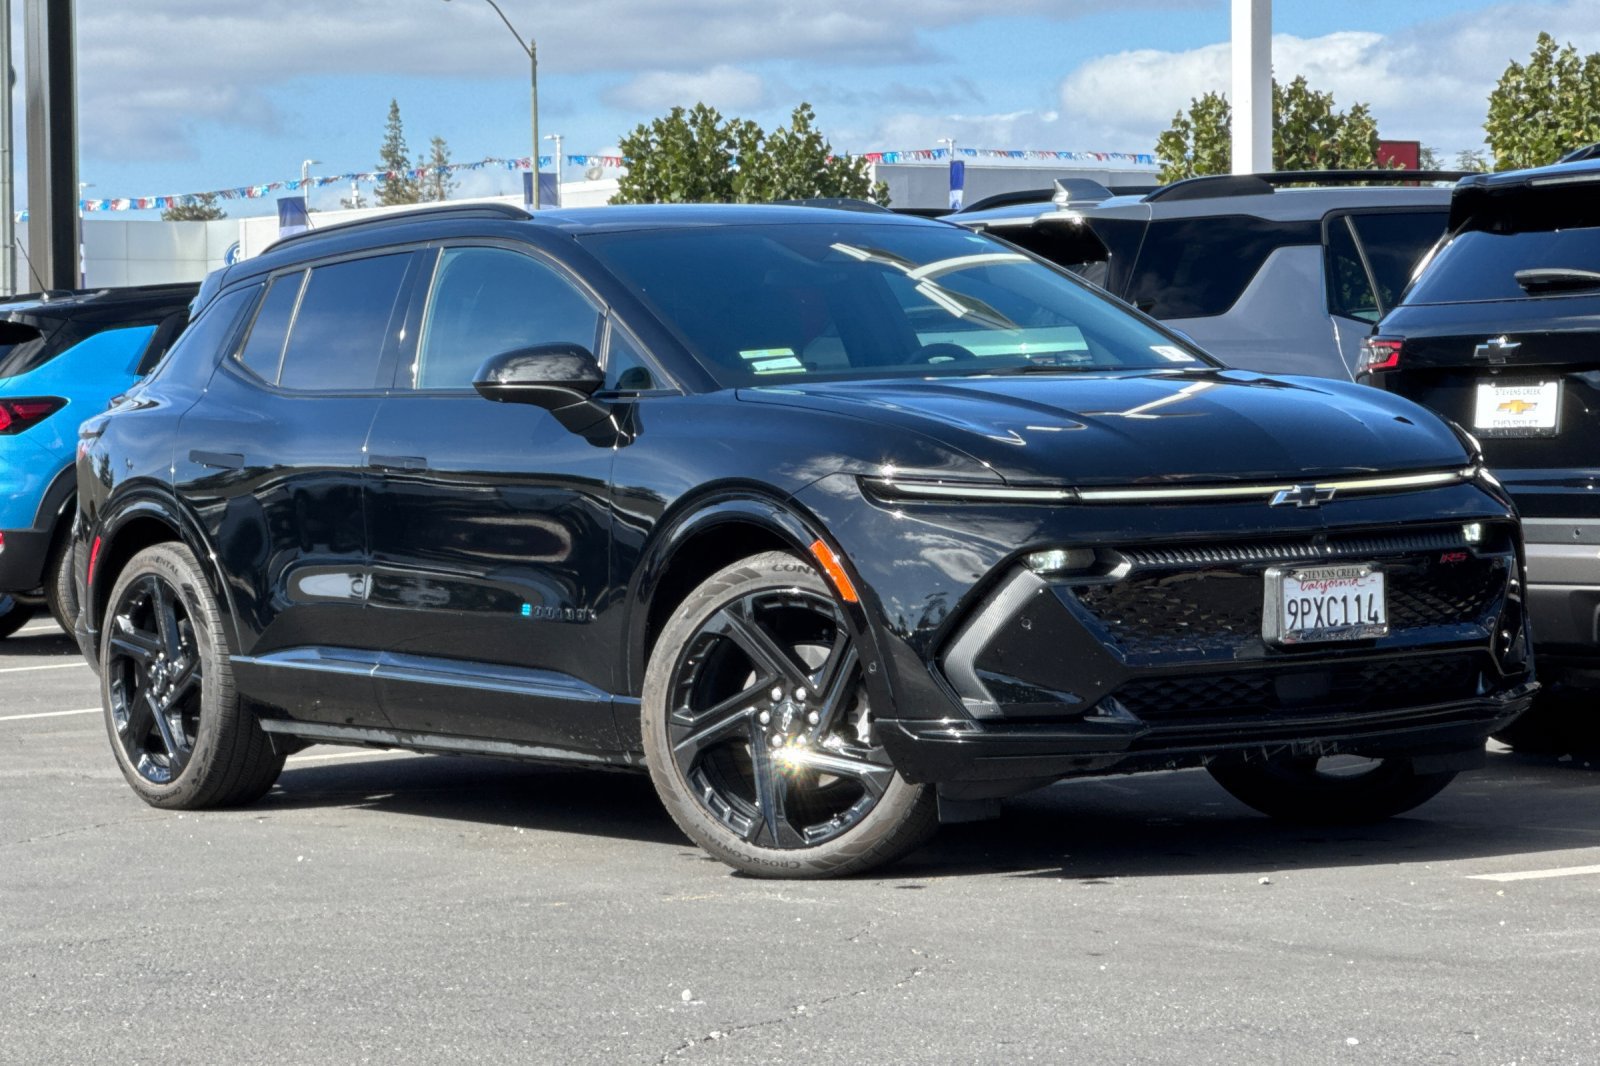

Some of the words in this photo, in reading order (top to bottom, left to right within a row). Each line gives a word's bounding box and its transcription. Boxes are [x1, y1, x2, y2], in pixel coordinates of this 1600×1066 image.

[1495, 388, 1521, 396] STEVENS
[1523, 387, 1541, 396] CREEK
[1303, 569, 1335, 580] STEVENS
[1336, 567, 1362, 578] CREEK
[1300, 578, 1364, 595] California
[1287, 592, 1379, 630] 9PXC114
